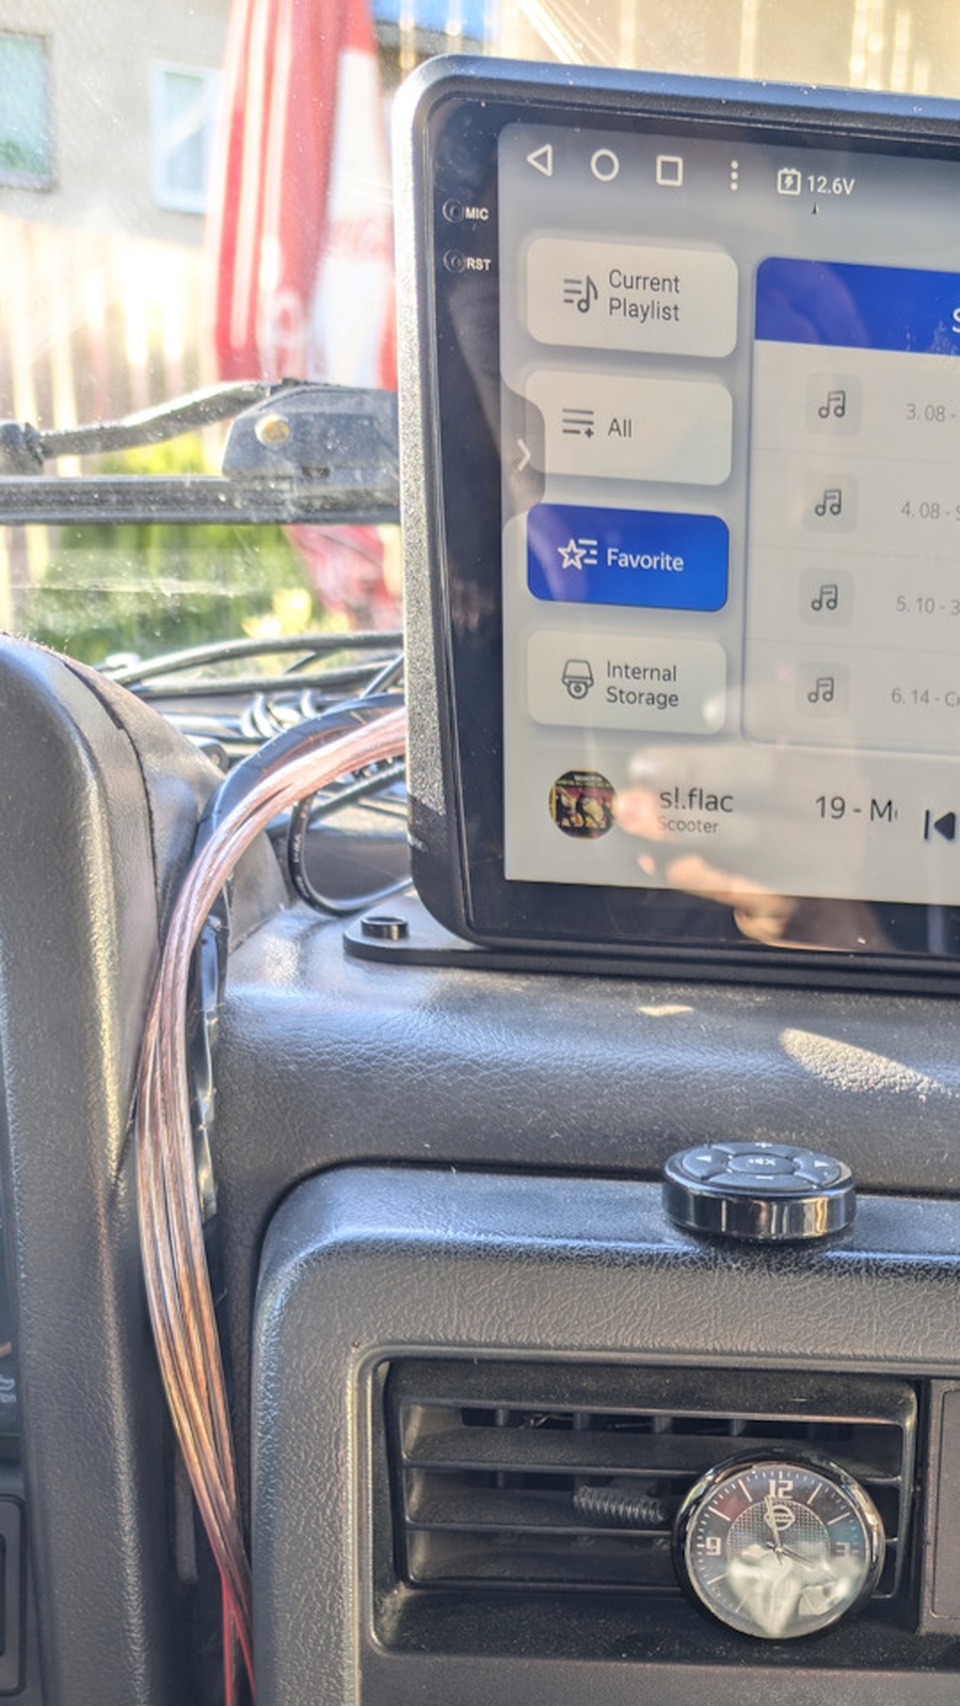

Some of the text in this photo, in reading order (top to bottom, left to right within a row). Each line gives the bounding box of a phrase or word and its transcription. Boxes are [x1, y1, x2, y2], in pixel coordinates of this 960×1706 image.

[807, 173, 855, 196] 12.6V
[465, 206, 489, 221] MIC
[466, 256, 492, 272] RST
[608, 268, 681, 294] Current
[608, 297, 681, 323] Playlist
[924, 404, 946, 422] 08
[607, 417, 633, 439] All
[919, 503, 940, 520] 08
[606, 547, 685, 574] Favorite
[916, 597, 935, 613] 10
[606, 660, 677, 683] Internal
[606, 686, 679, 710] Storage
[911, 689, 929, 706] 14
[816, 796, 845, 819] 19
[659, 815, 719, 834] Scooter
[768, 1479, 794, 1500] 12
[706, 1537, 722, 1556] 9
